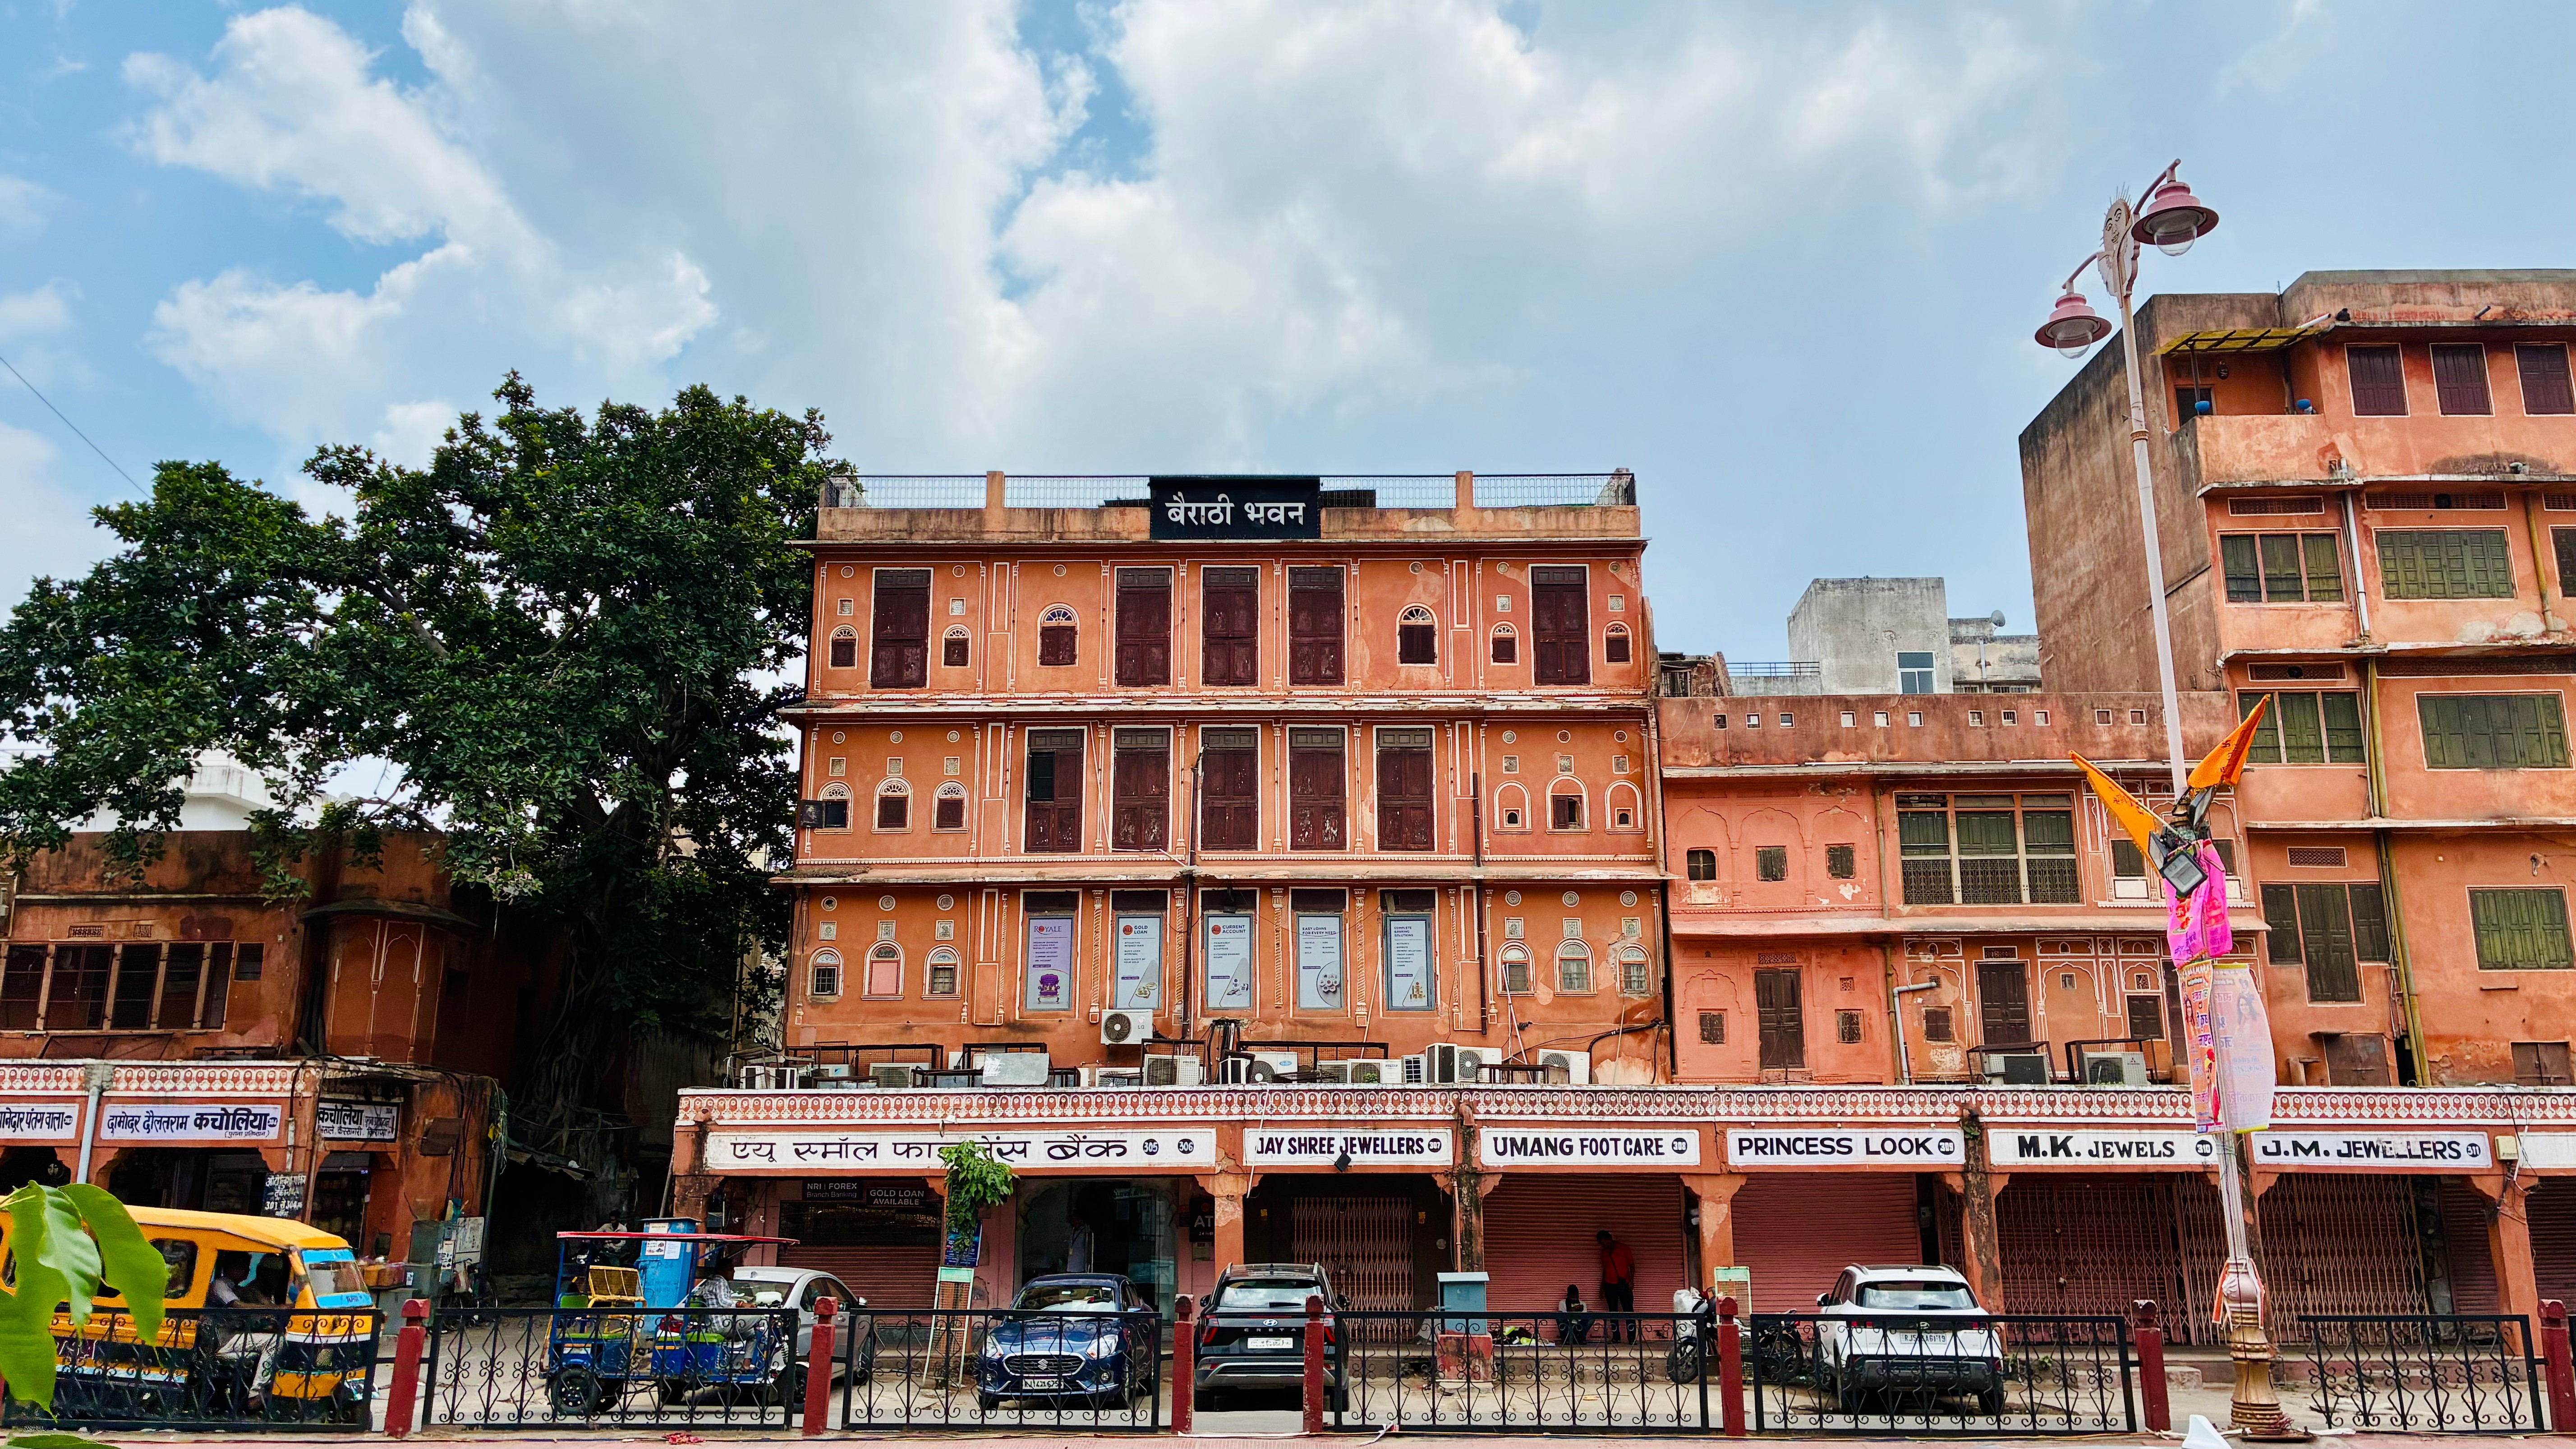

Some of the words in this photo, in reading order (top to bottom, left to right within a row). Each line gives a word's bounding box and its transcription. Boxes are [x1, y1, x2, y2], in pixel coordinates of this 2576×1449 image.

[1165, 492, 1234, 525] बैराठी
[1244, 502, 1306, 525] भवन
[0, 1107, 25, 1132] ानेदार
[45, 1112, 64, 1131] वाला
[107, 1111, 141, 1136] दामोदर
[193, 1108, 270, 1131] कचोलिया
[318, 1104, 364, 1125] कचोलिया
[793, 1138, 879, 1161] स्मॉल
[1044, 1134, 1127, 1160] बैंक
[1144, 1142, 1158, 1151] 305
[1179, 1142, 1193, 1151] 306
[1256, 1137, 1284, 1154] JAY
[1288, 1137, 1335, 1155] SHREE
[1340, 1137, 1424, 1154] JEWELLERS
[1429, 1141, 1440, 1150] 307
[1493, 1136, 1573, 1156] UMANG
[1579, 1138, 1621, 1156] FOOT
[1623, 1138, 1665, 1156] CARE
[1673, 1141, 1687, 1150] 308
[1738, 1137, 1853, 1155] PRINCESS
[1865, 1137, 1934, 1155] LOOK
[1939, 1142, 1954, 1152] 309
[2018, 1136, 2081, 1158] M.K.
[2088, 1141, 2175, 1158] JEWELS
[2198, 1143, 2210, 1153] 310
[2262, 1141, 2330, 1157] J.M.
[2337, 1141, 2461, 1159] JEWELLERS
[2466, 1146, 2479, 1155] 311
[1194, 1215, 1214, 1227] AT
